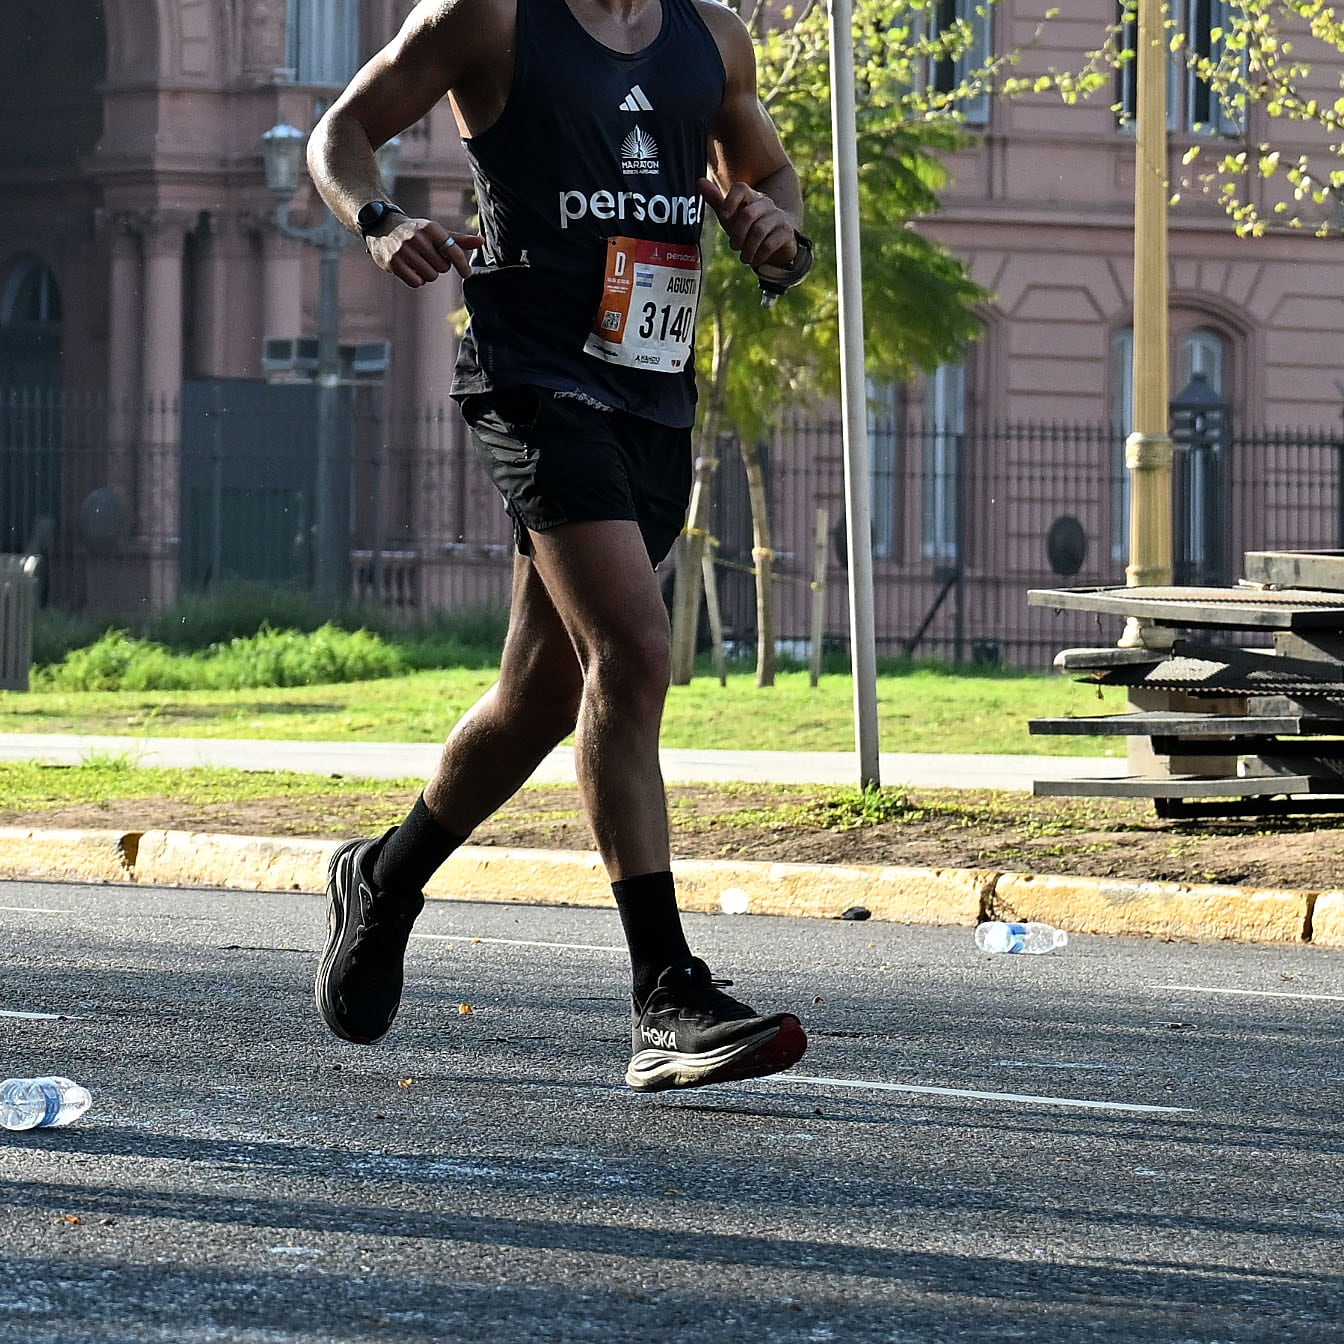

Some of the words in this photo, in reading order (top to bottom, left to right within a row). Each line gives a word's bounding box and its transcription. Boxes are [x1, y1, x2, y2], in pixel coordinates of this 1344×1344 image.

[621, 160, 660, 169] MARATON
[559, 189, 703, 229] personal
[614, 251, 626, 277] D
[639, 302, 692, 344] 3140
[640, 1024, 678, 1050] HOKA
